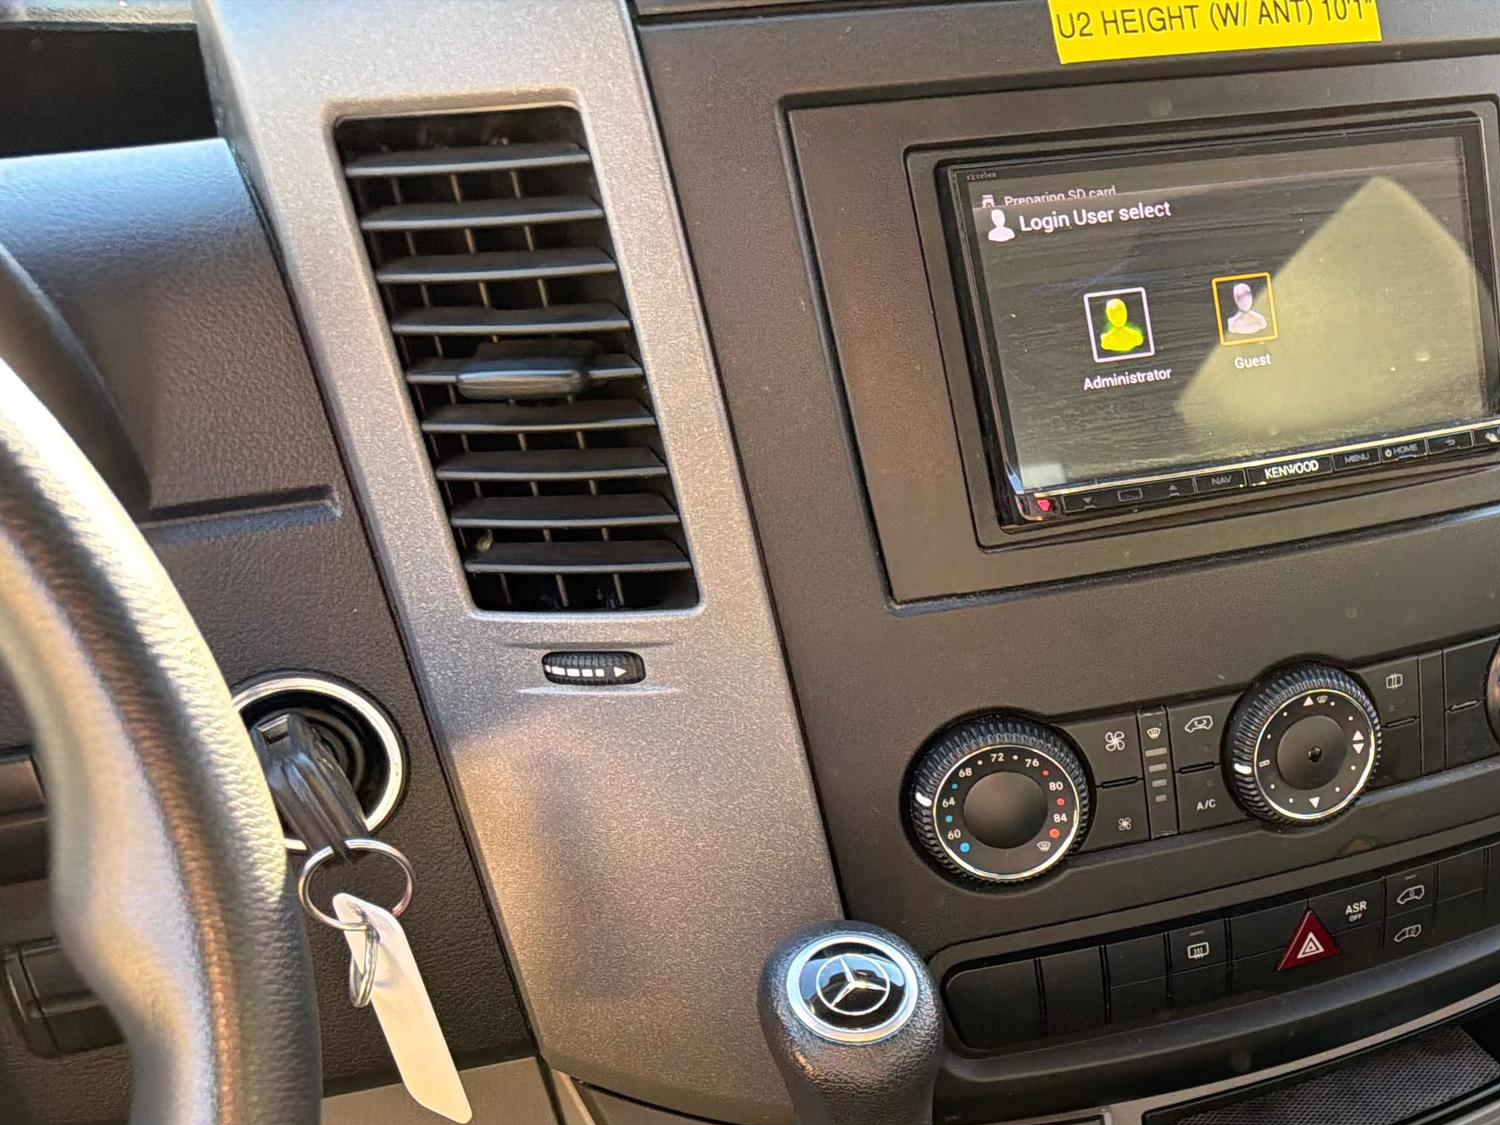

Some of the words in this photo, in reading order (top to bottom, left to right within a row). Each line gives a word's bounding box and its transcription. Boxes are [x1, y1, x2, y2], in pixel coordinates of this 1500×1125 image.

[1057, 12, 1094, 39] U2
[1101, 4, 1201, 36] HEIGHT
[1209, 0, 1249, 31] (W/
[1257, 0, 1314, 26] ANT)
[1019, 211, 1070, 234] Login
[1074, 208, 1114, 227] User
[1119, 201, 1172, 222] select
[1234, 353, 1272, 369] Guest
[1083, 368, 1172, 391] Administrator
[1393, 443, 1418, 456] HOME
[1344, 452, 1370, 464] MENU
[1264, 459, 1320, 480] KENWOOD
[1211, 474, 1232, 487] NAV
[990, 752, 1005, 763] 72
[1025, 758, 1040, 768] 76
[958, 768, 973, 778] 68
[1049, 781, 1063, 791] 80
[942, 797, 956, 808] 64
[1197, 798, 1216, 811] A/C
[1053, 813, 1068, 823] 84
[947, 829, 961, 840] 60
[1345, 900, 1367, 916] ASR
